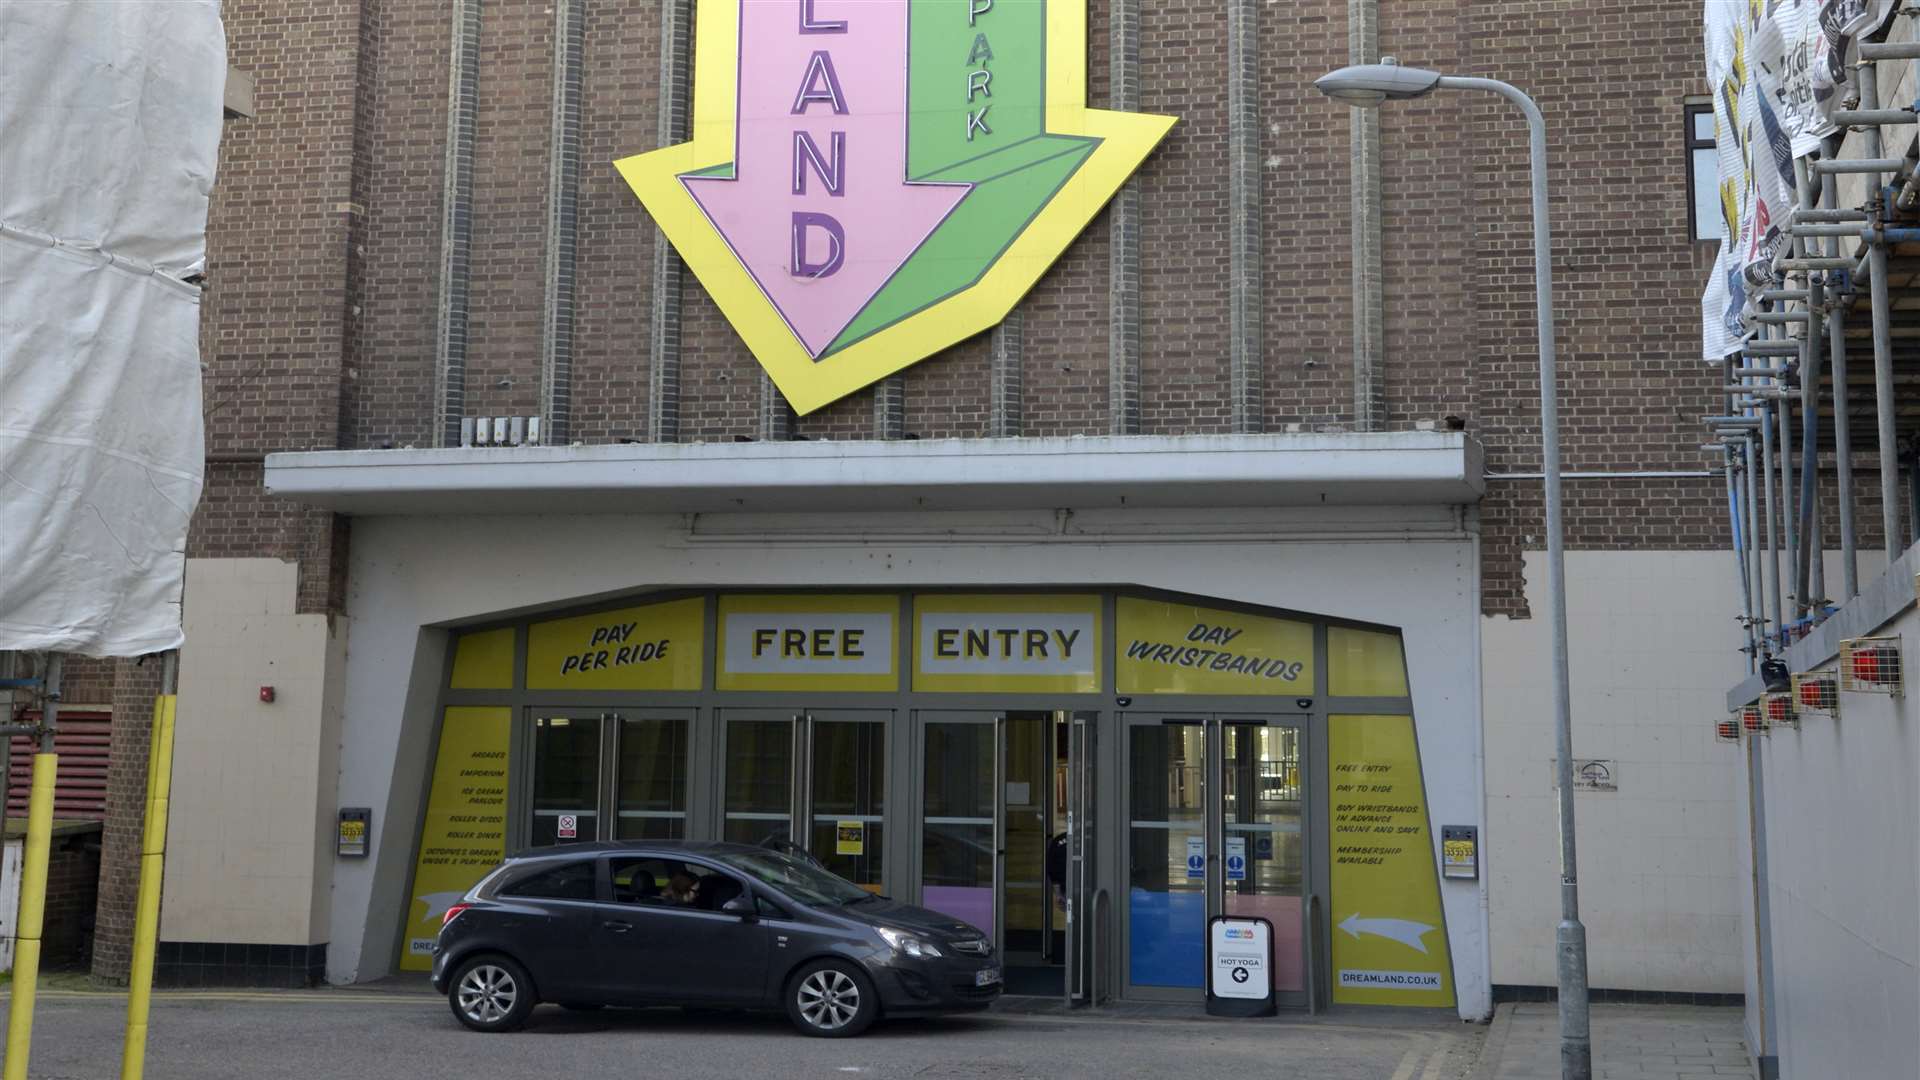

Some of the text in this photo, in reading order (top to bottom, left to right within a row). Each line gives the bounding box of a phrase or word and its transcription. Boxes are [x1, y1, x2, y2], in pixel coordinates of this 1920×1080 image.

[966, 0, 994, 142] PARK
[590, 621, 638, 647] PAY
[1185, 623, 1243, 646] DAY
[753, 628, 1081, 660] FREE ENTRY
[560, 639, 670, 676] PER RIDE
[1126, 639, 1304, 682] WRISTBANDS
[460, 769, 505, 777] EMPORIUM
[1336, 764, 1393, 773] FREE ENTRY
[476, 787, 504, 795] CREAM
[1336, 784, 1394, 793] PAY TO RIDE
[1336, 804, 1419, 814] BUY WRISTBANDS
[449, 815, 477, 823] ROLLER
[1336, 814, 1393, 823] IN ADVANCE
[1336, 825, 1420, 834] ONLINE AND SAVE
[446, 831, 502, 839] ROLLER DINER
[1336, 846, 1403, 856] MEMBERSHIP
[1336, 857, 1385, 865] AVAILABLE
[1341, 973, 1438, 985] DREAMLAND.CO.UK
